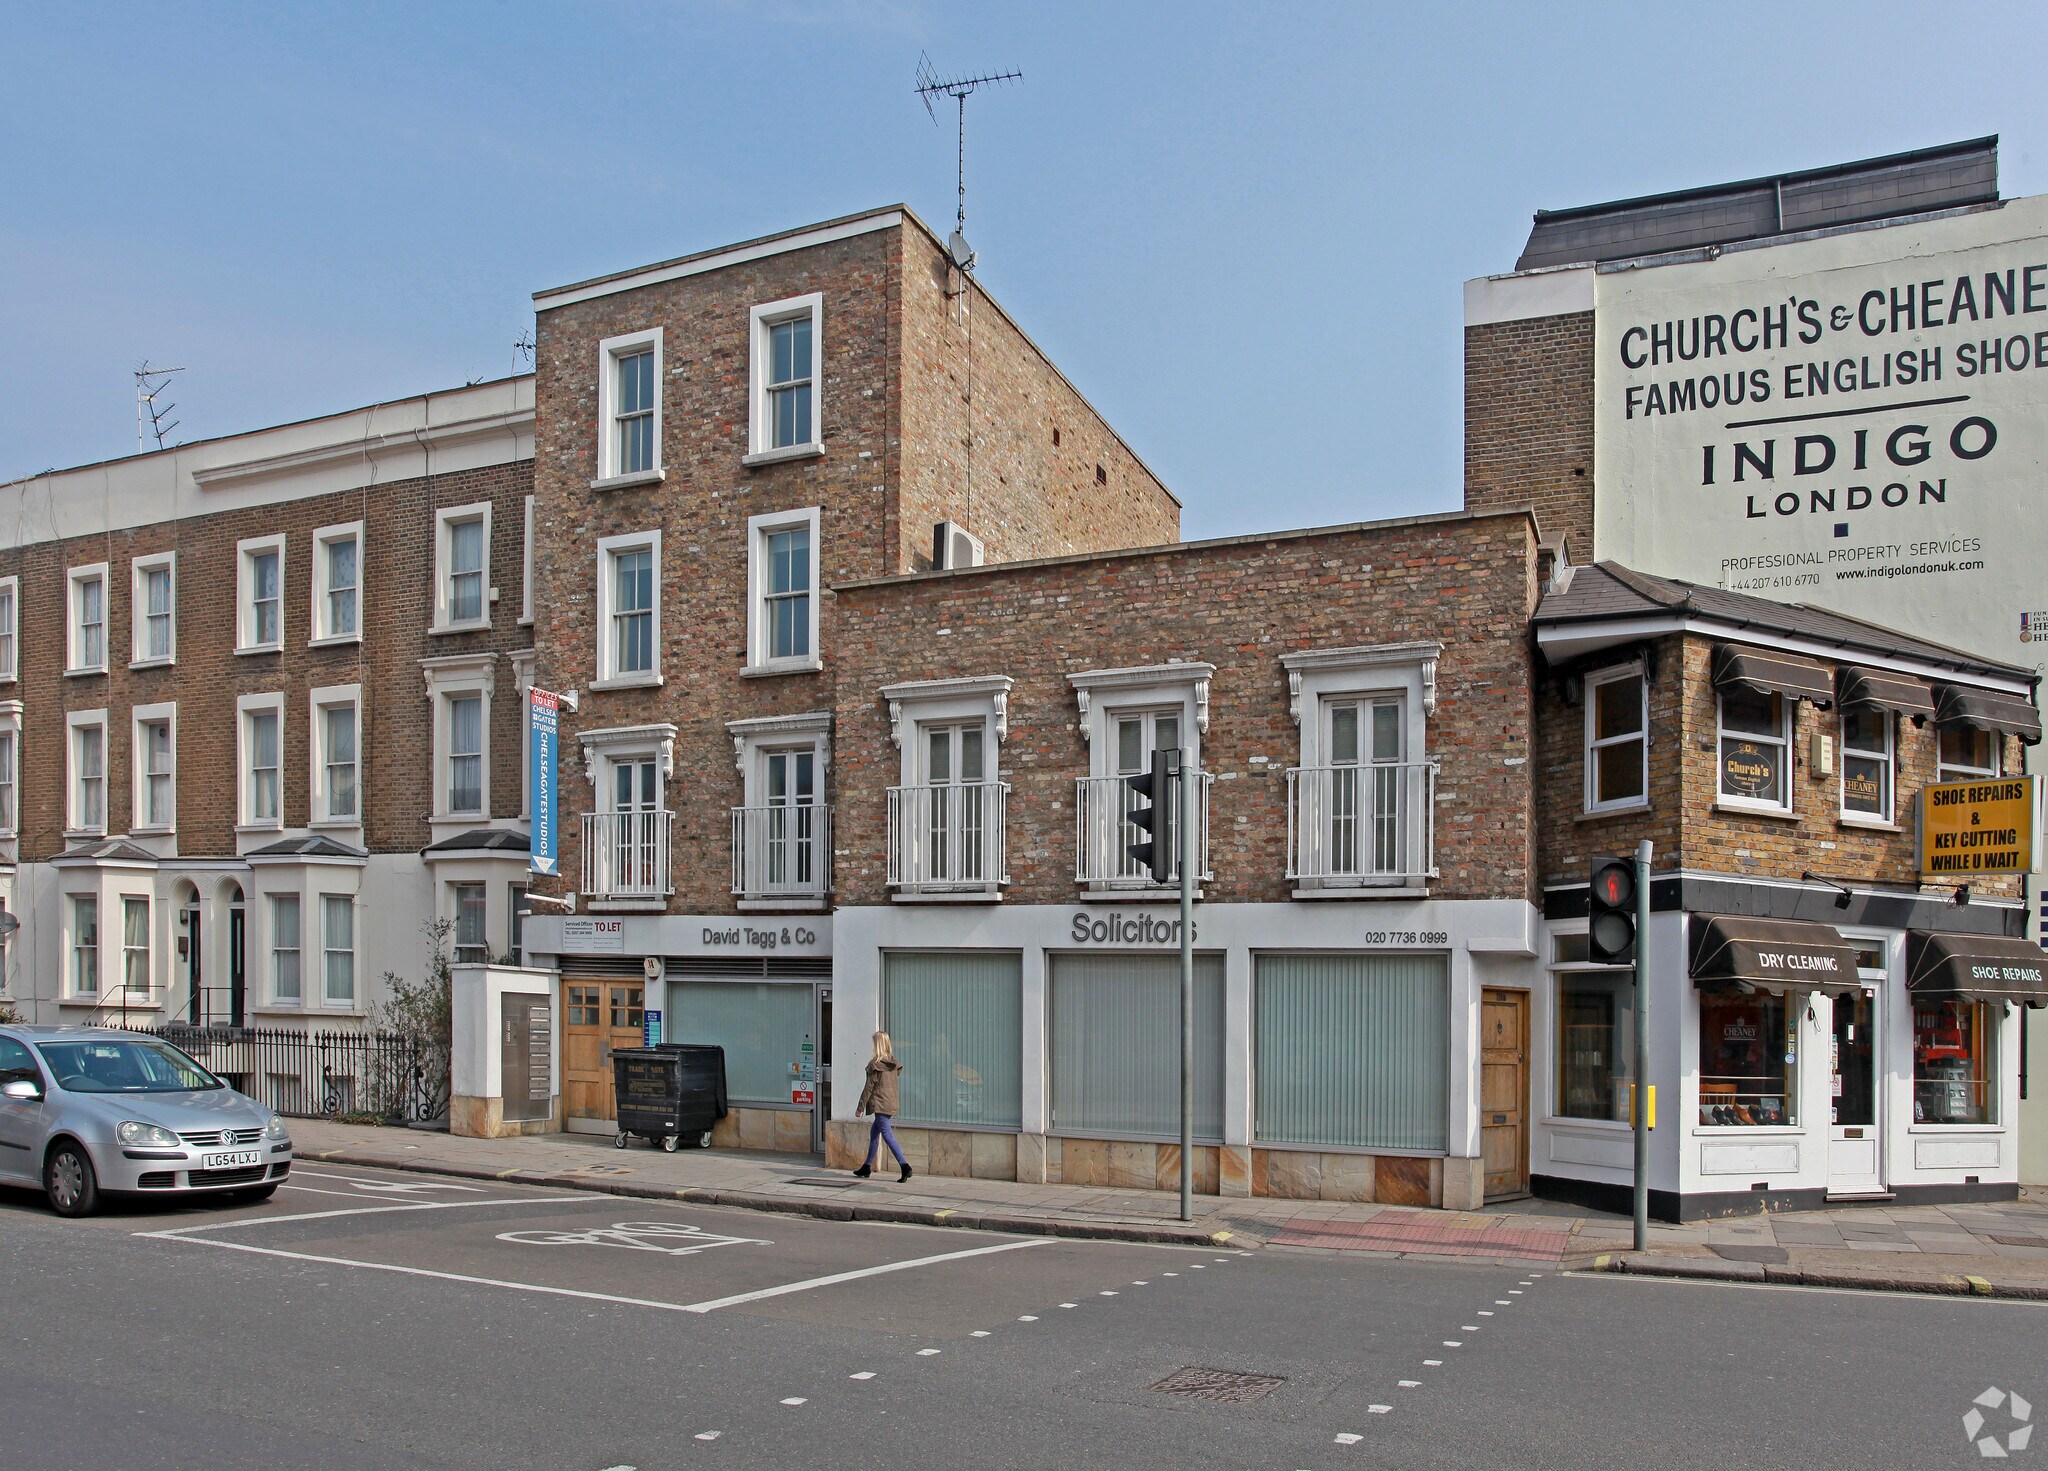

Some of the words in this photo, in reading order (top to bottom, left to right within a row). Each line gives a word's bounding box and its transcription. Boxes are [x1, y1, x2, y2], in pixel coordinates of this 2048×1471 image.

[1620, 296, 1822, 369] CHURCH'S
[1830, 305, 1854, 331] &
[1626, 368, 1771, 420] FAMOUS
[1784, 346, 1941, 399] ENGLISH
[1702, 416, 1997, 485] INDIGO
[1746, 479, 1947, 518] LONDON
[1721, 552, 1823, 571] PROFESSIONAL
[1828, 544, 1901, 563] PROPERTY
[1910, 538, 1981, 556] SERVICES
[1836, 559, 1984, 581] www.indigolondonuk.com
[1731, 580, 1750, 590] +44
[1752, 577, 1770, 589] 207
[1773, 575, 1792, 587] 610
[1794, 573, 1820, 587] 6770
[534, 688, 558, 700] OFFICES
[534, 696, 543, 705] TO
[544, 699, 555, 708] LET
[533, 705, 556, 717] CHELSEA
[537, 714, 552, 725] GATE
[533, 722, 557, 735] STUDIOS
[1727, 760, 1769, 777] Church's
[540, 732, 549, 856] CHELSEAGATESTUDIOS
[1844, 780, 1878, 793] CHEANEY
[1933, 788, 1965, 806] SHOE
[1968, 783, 2023, 803] REPAIRS
[1971, 812, 1980, 825] &
[1935, 832, 1958, 849] KEY
[1960, 829, 2016, 847] CUTTING
[1931, 854, 1969, 871] WHILE
[1972, 853, 1981, 869] U
[1984, 852, 2019, 868] WAIT
[595, 922, 605, 931] TO
[607, 922, 621, 931] LET
[703, 927, 739, 944] David
[744, 927, 776, 949] Tagg
[781, 927, 791, 944] &
[795, 927, 815, 944] Co
[1365, 931, 1386, 944] 020
[1389, 931, 1416, 944] 7736
[1420, 931, 1448, 944] 0999
[1758, 952, 1784, 968] DRY
[1787, 954, 1838, 971] CLEANING
[1972, 966, 2000, 979] SHOE
[2002, 967, 2043, 982] REPAIRS
[1723, 1027, 1757, 1037] CHEANEY
[208, 1154, 236, 1167] LG54
[238, 1152, 258, 1164] LXJ
